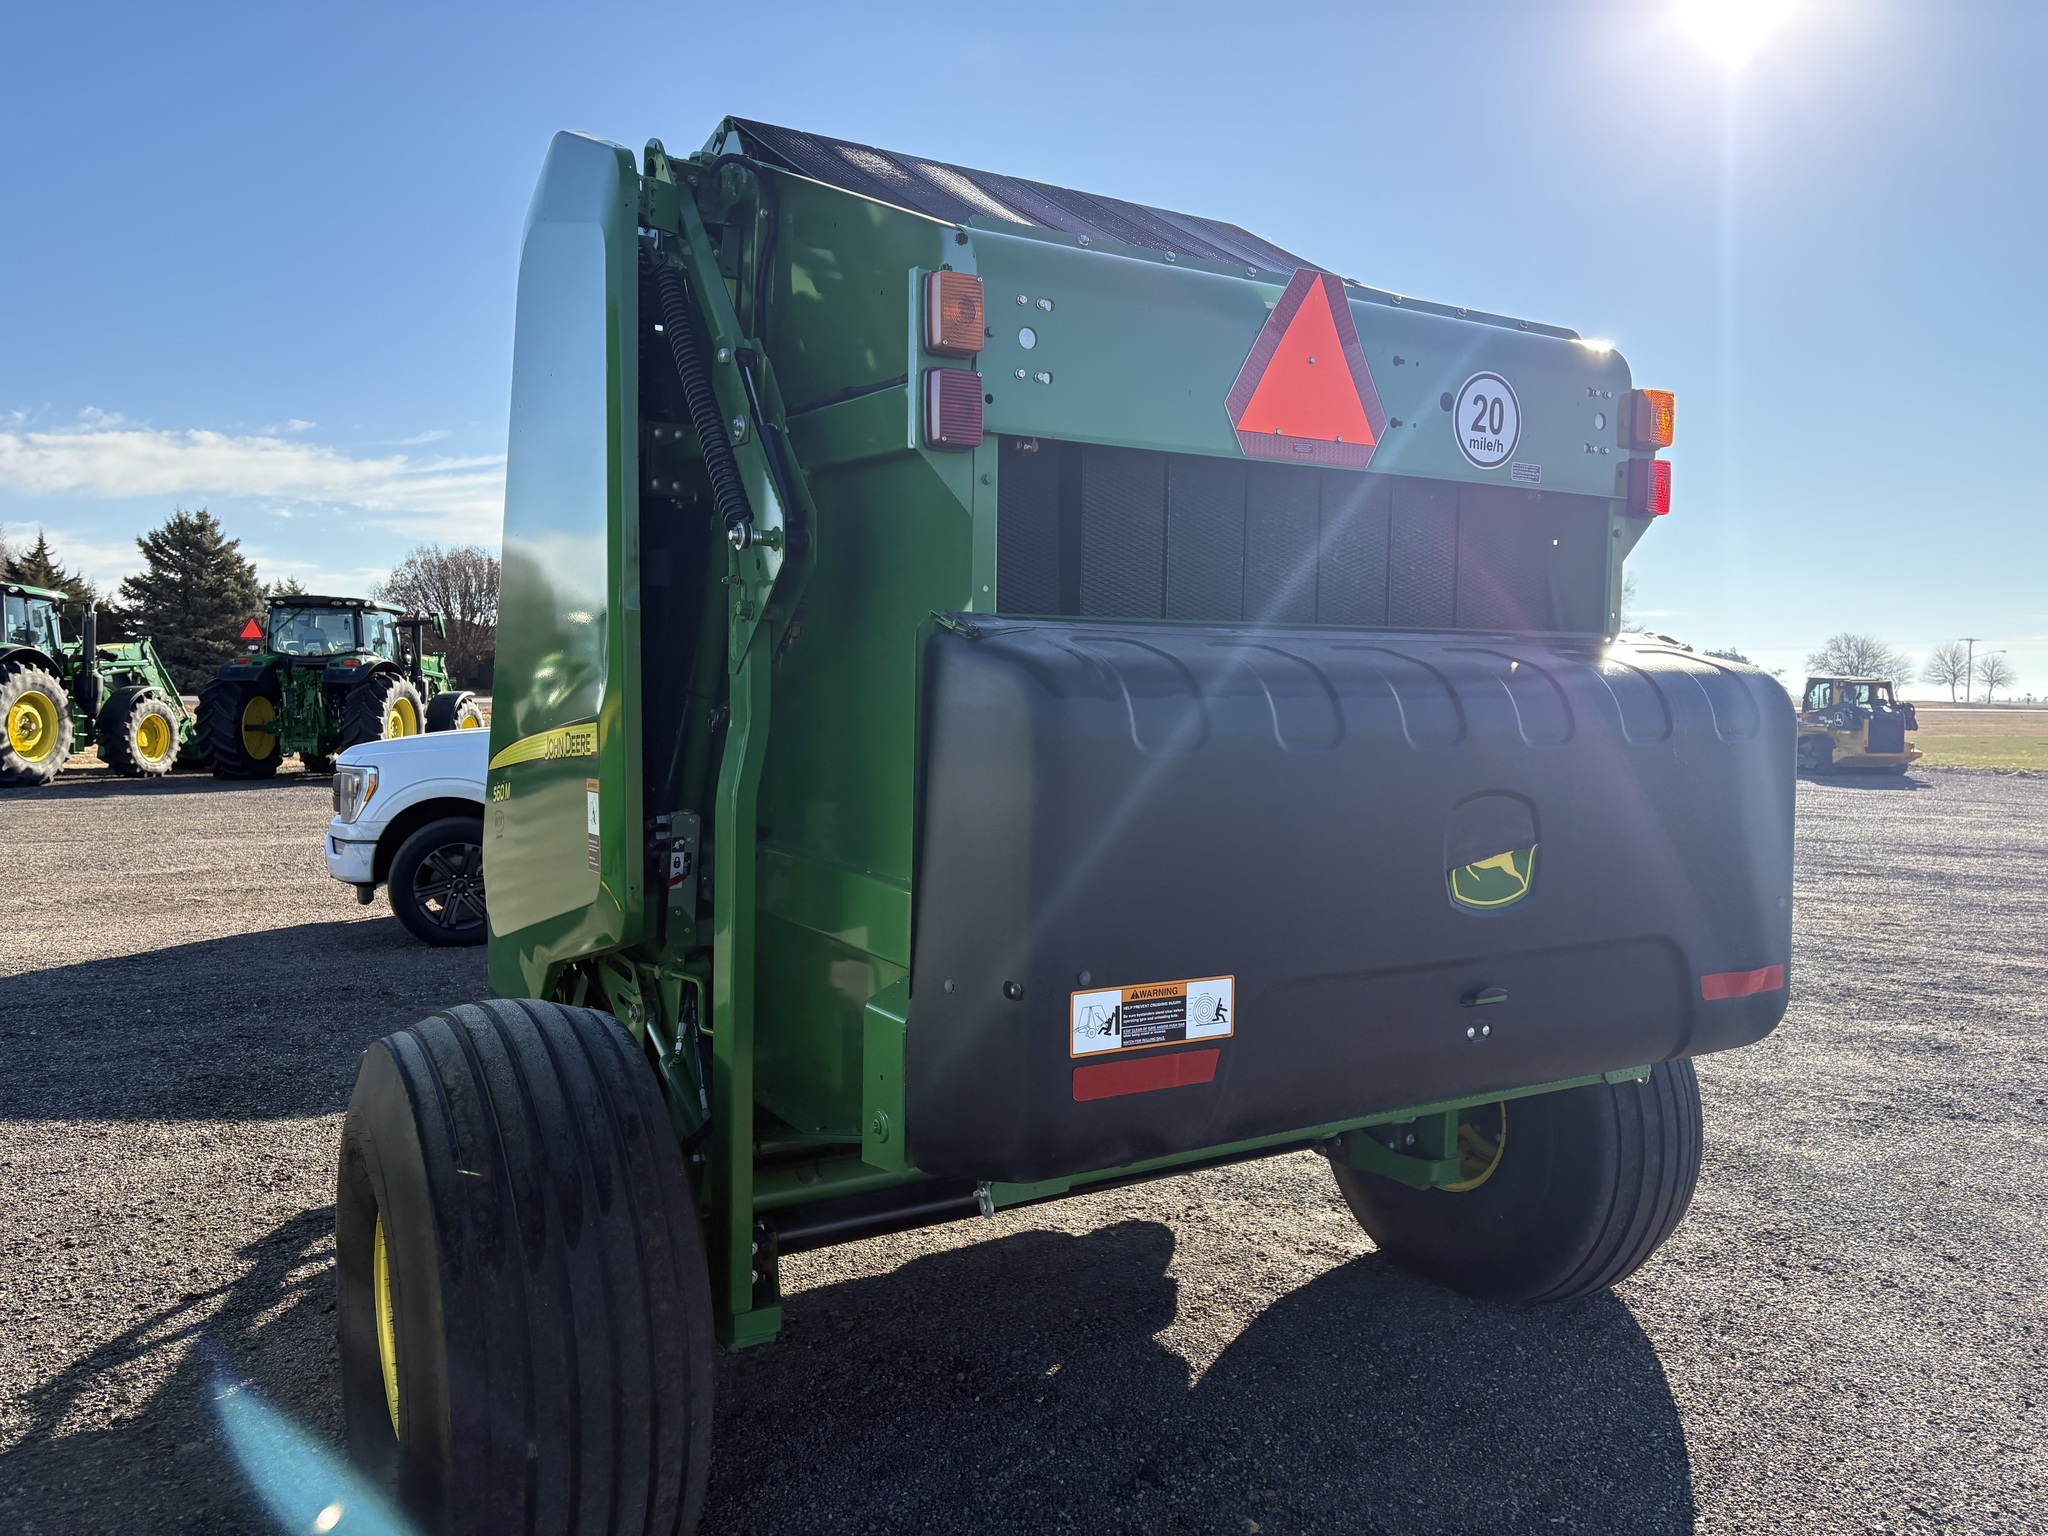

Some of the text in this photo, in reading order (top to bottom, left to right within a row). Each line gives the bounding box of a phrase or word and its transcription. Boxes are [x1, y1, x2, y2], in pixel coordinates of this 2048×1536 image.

[1471, 394, 1504, 435] 20
[1469, 437, 1504, 453] mile/h
[545, 732, 591, 758] JOHN DEERE
[1139, 987, 1178, 999] WARNING
